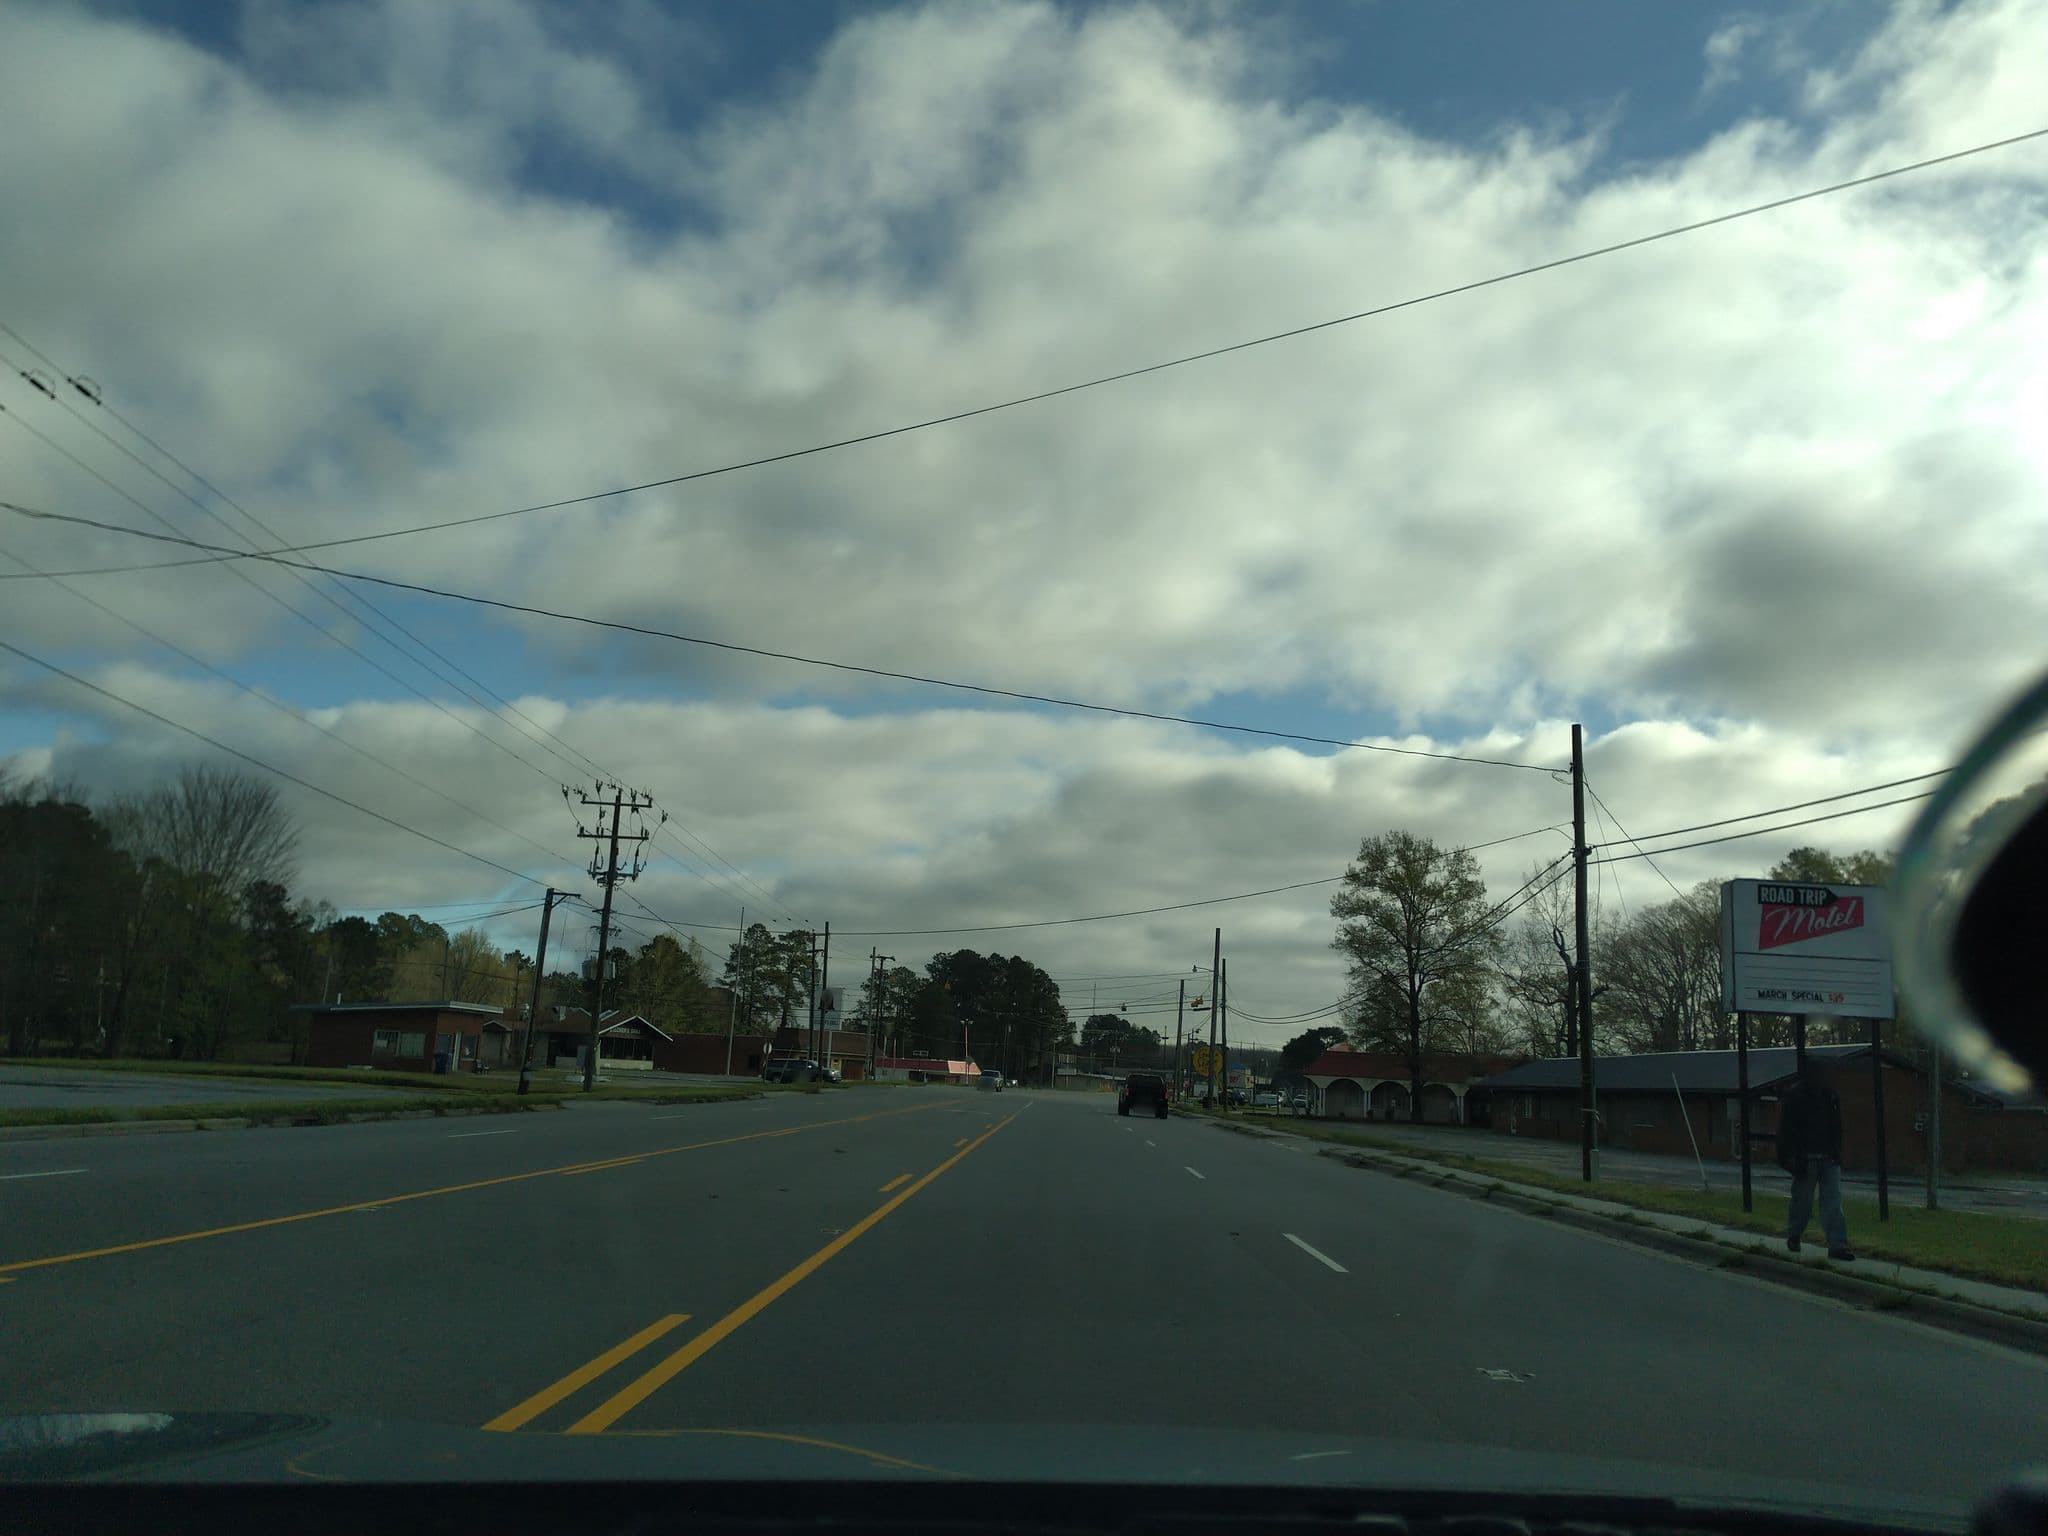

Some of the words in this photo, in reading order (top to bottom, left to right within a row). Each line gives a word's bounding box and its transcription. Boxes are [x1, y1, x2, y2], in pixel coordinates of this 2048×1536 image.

[1760, 886, 1794, 904] ROAD
[1799, 888, 1827, 906] TRIP
[1764, 899, 1857, 941] Motel
[1758, 989, 1787, 1001] MARCH
[1791, 991, 1823, 1002] SPECIAL
